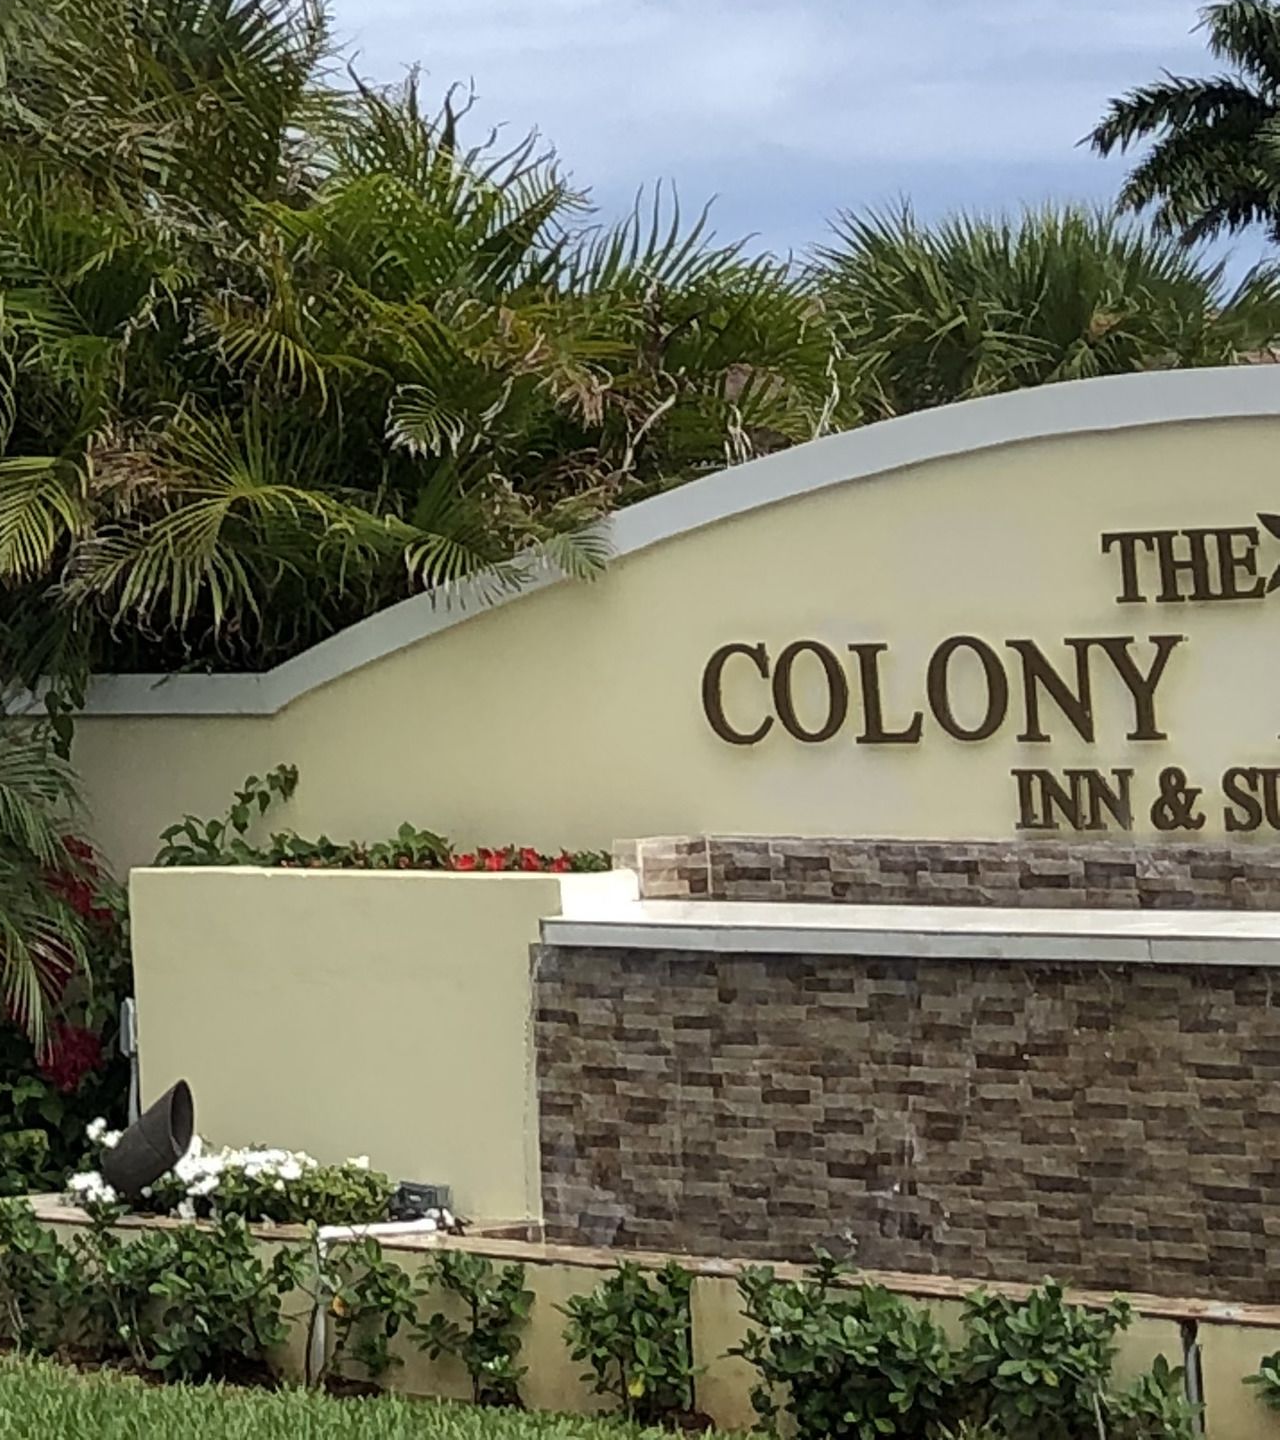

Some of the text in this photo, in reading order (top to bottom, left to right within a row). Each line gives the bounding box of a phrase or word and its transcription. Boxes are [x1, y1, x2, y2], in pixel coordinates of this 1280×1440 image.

[1101, 527, 1267, 603] THE
[702, 635, 1184, 744] COLONY
[1011, 768, 1134, 831] INN
[1150, 766, 1206, 831] &
